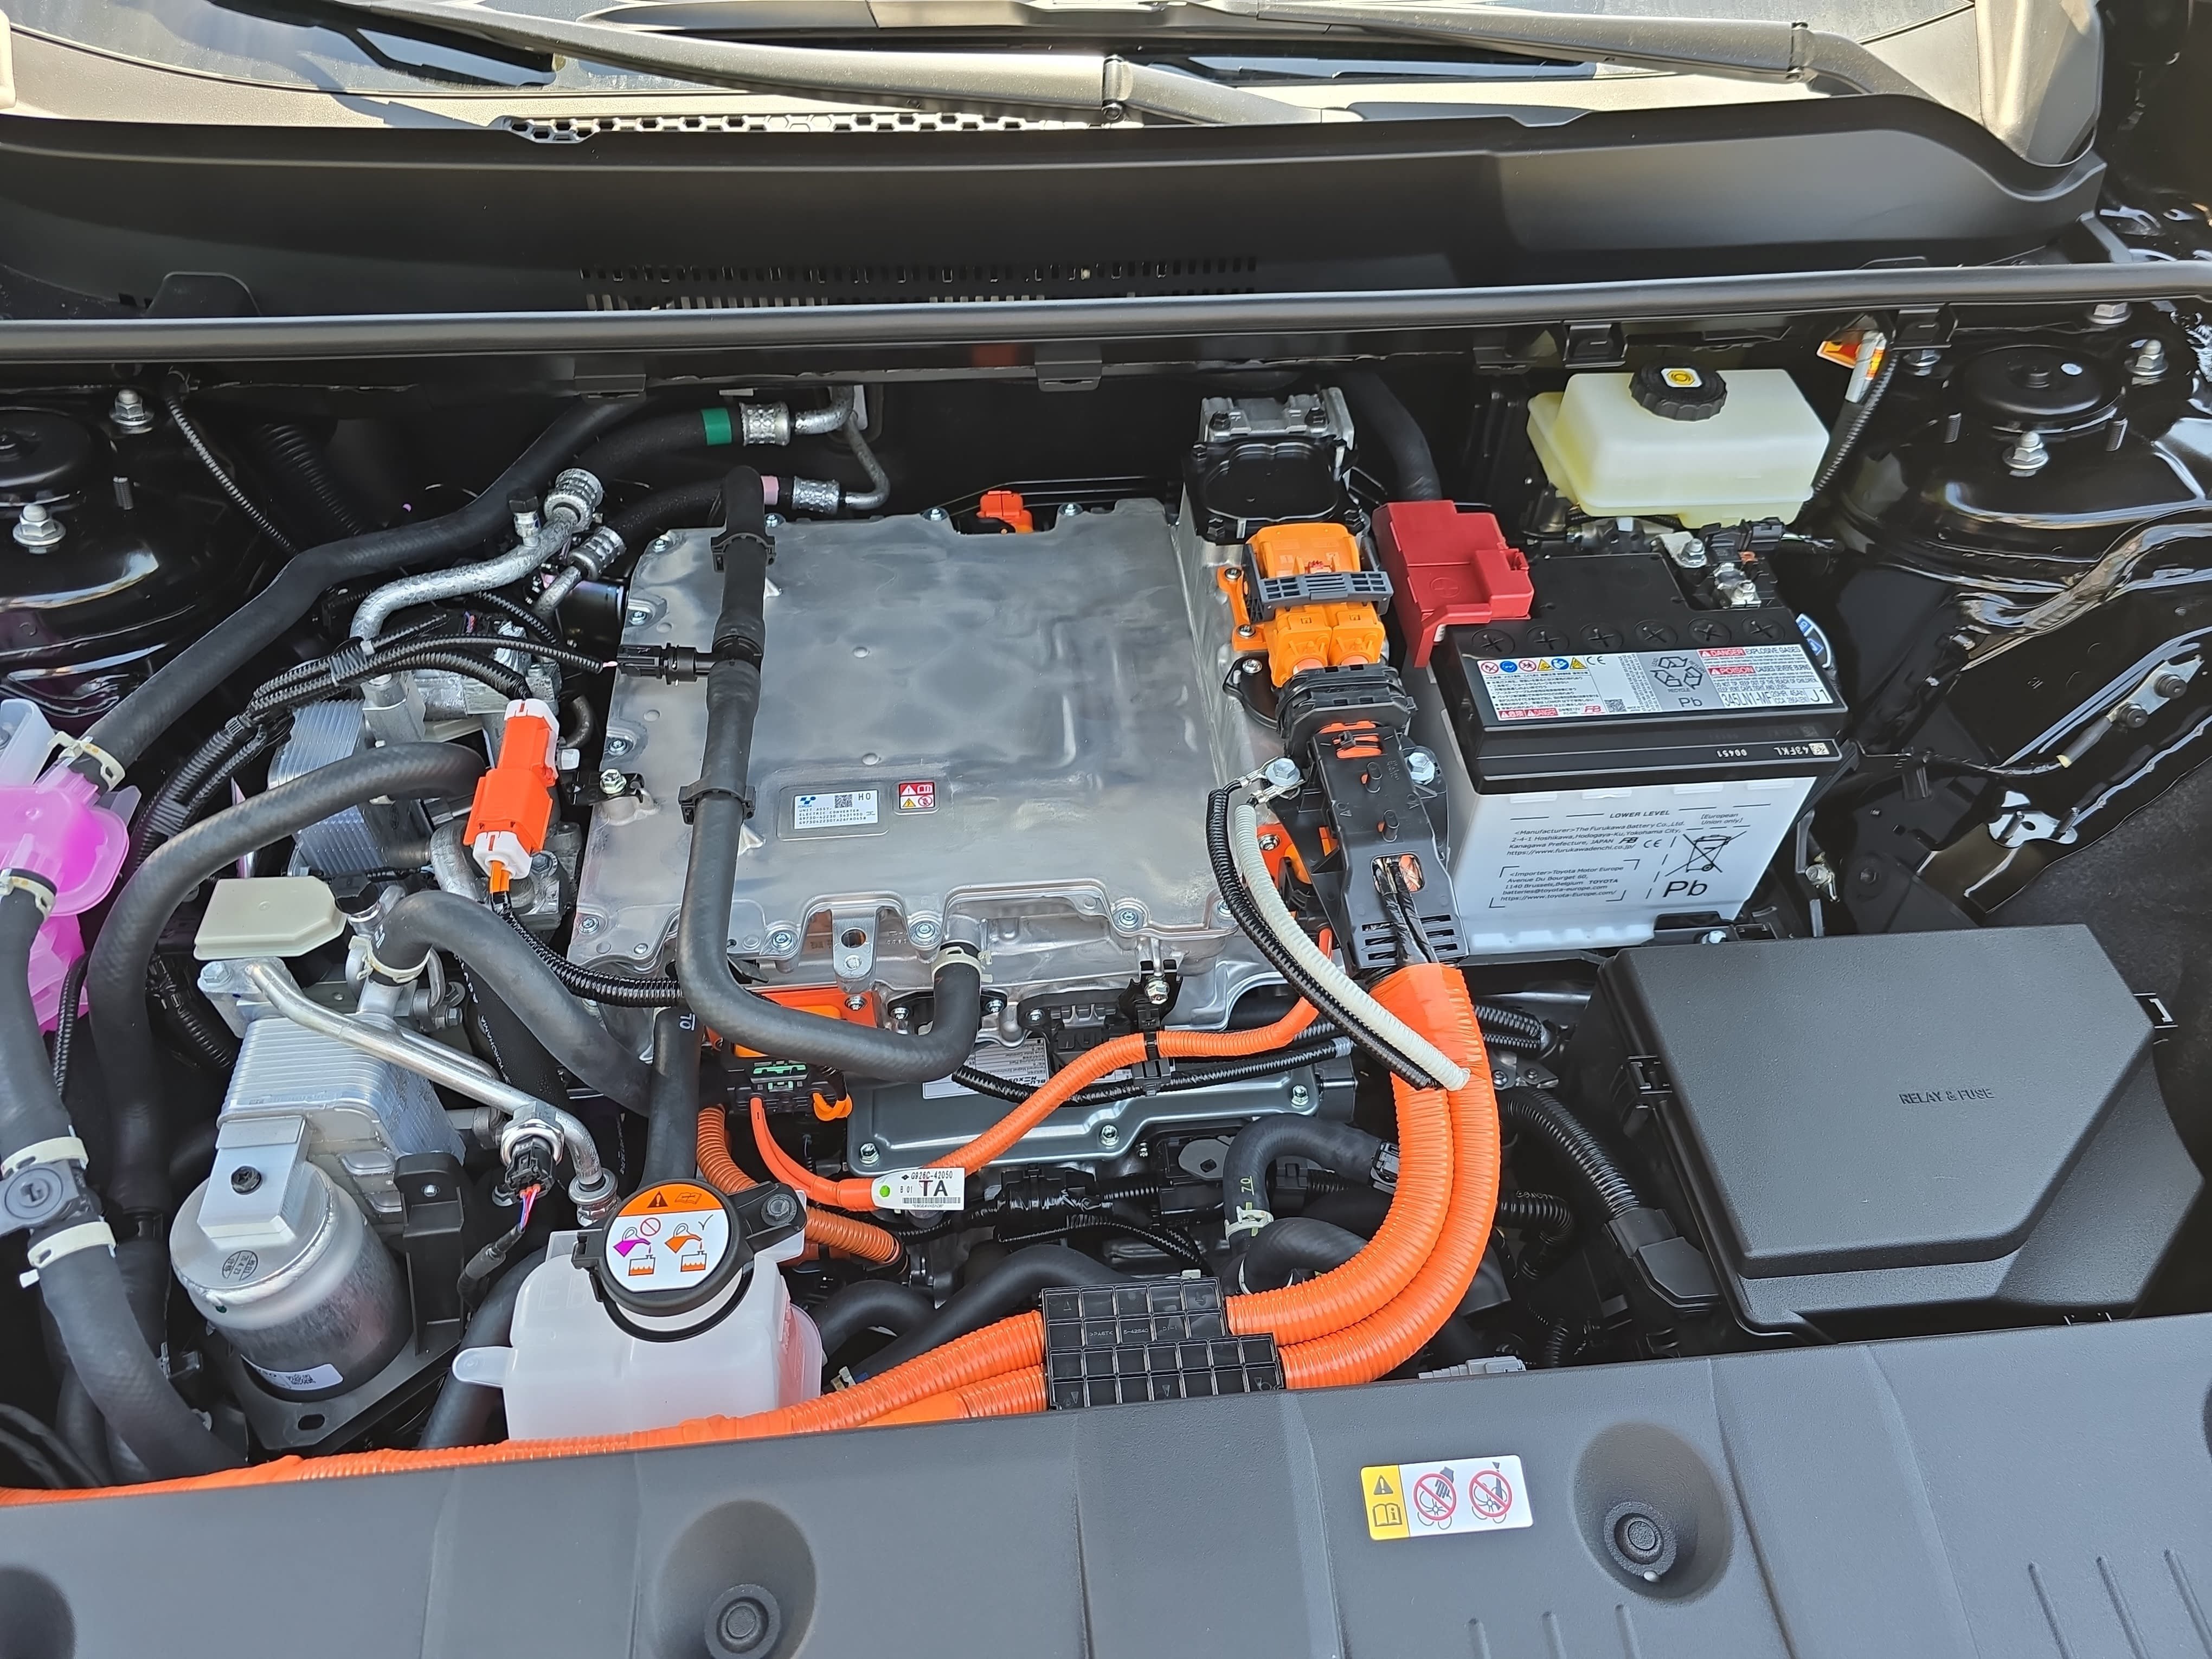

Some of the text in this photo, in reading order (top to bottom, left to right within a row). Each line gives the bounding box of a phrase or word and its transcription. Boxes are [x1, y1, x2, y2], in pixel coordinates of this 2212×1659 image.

[1711, 649, 1744, 657] DANGER
[1746, 647, 1779, 655] EXPLOSIVE
[1720, 667, 1754, 675] POISON
[1678, 697, 1703, 708] Pb
[1716, 748, 1747, 757] 00451
[1662, 879, 1708, 898] Pb
[480, 1014, 504, 1070] YOKOHAMA
[1899, 1088, 1995, 1104] RELAY & FUSE
[911, 1171, 953, 1180] G926C-42050
[918, 1180, 948, 1197] TA
